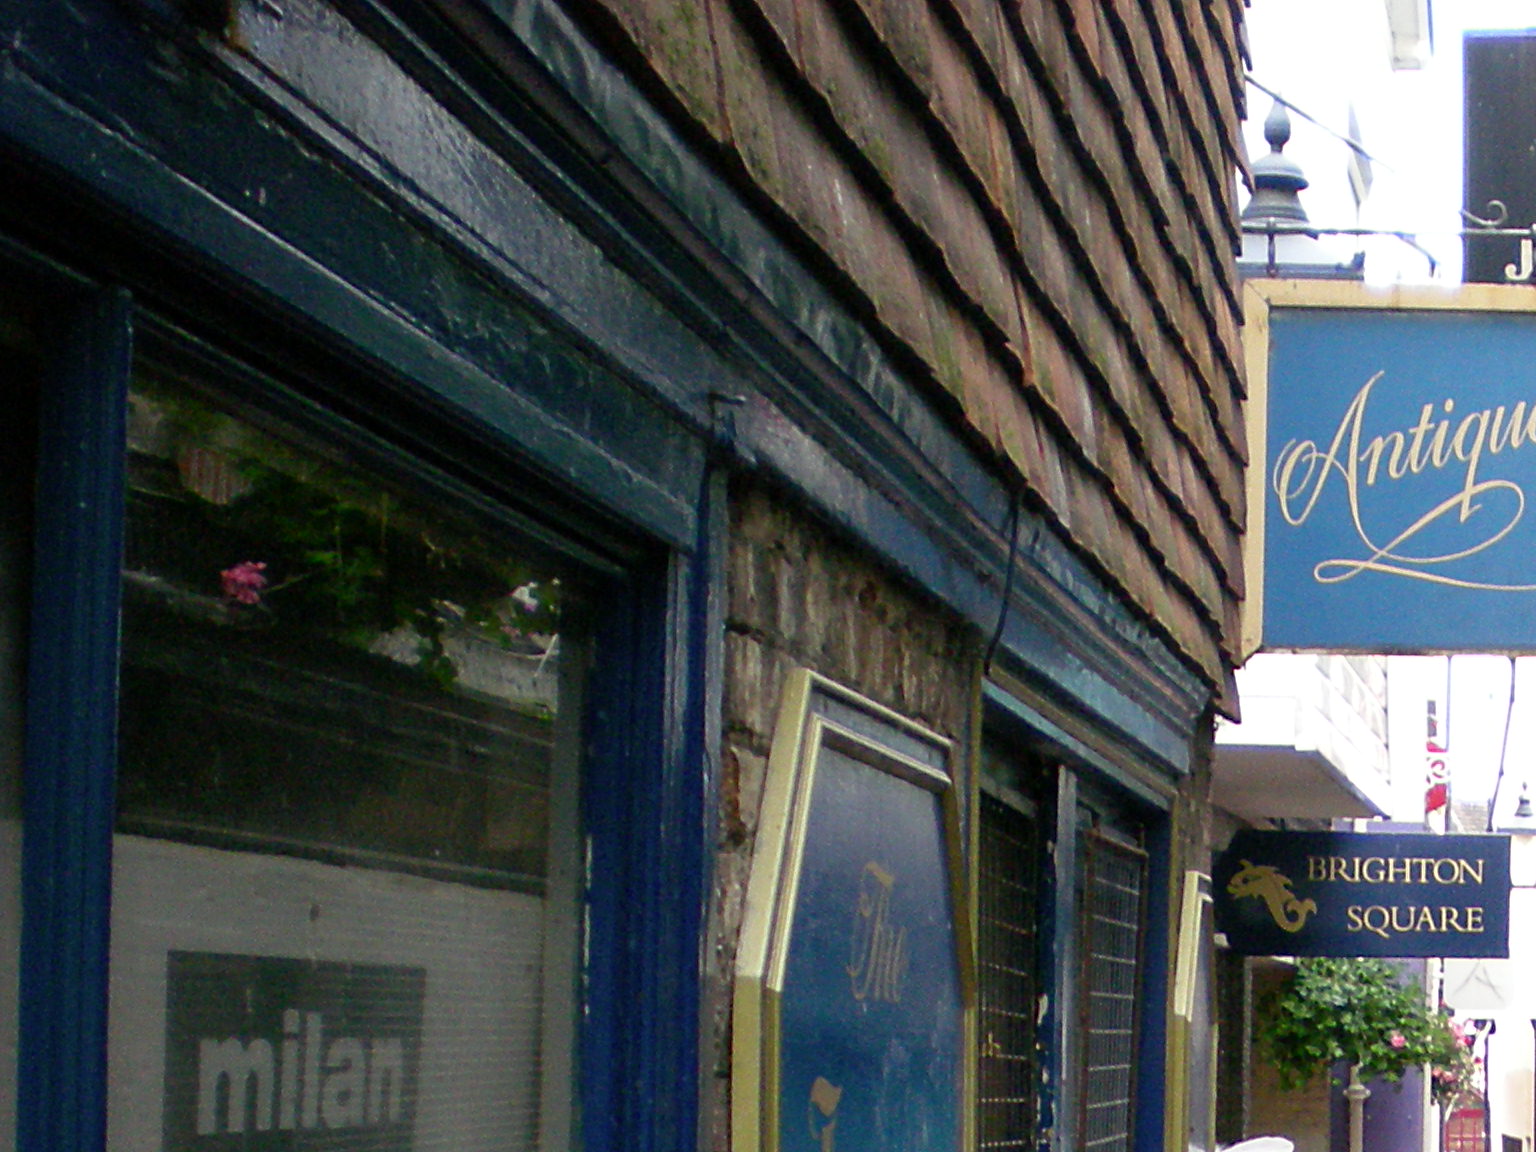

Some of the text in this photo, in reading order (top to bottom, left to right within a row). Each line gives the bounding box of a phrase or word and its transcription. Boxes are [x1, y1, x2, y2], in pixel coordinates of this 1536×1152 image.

[1306, 855, 1485, 886] BRIGHTON
[1346, 904, 1485, 940] SQUARE
[197, 1008, 401, 1136] milan
